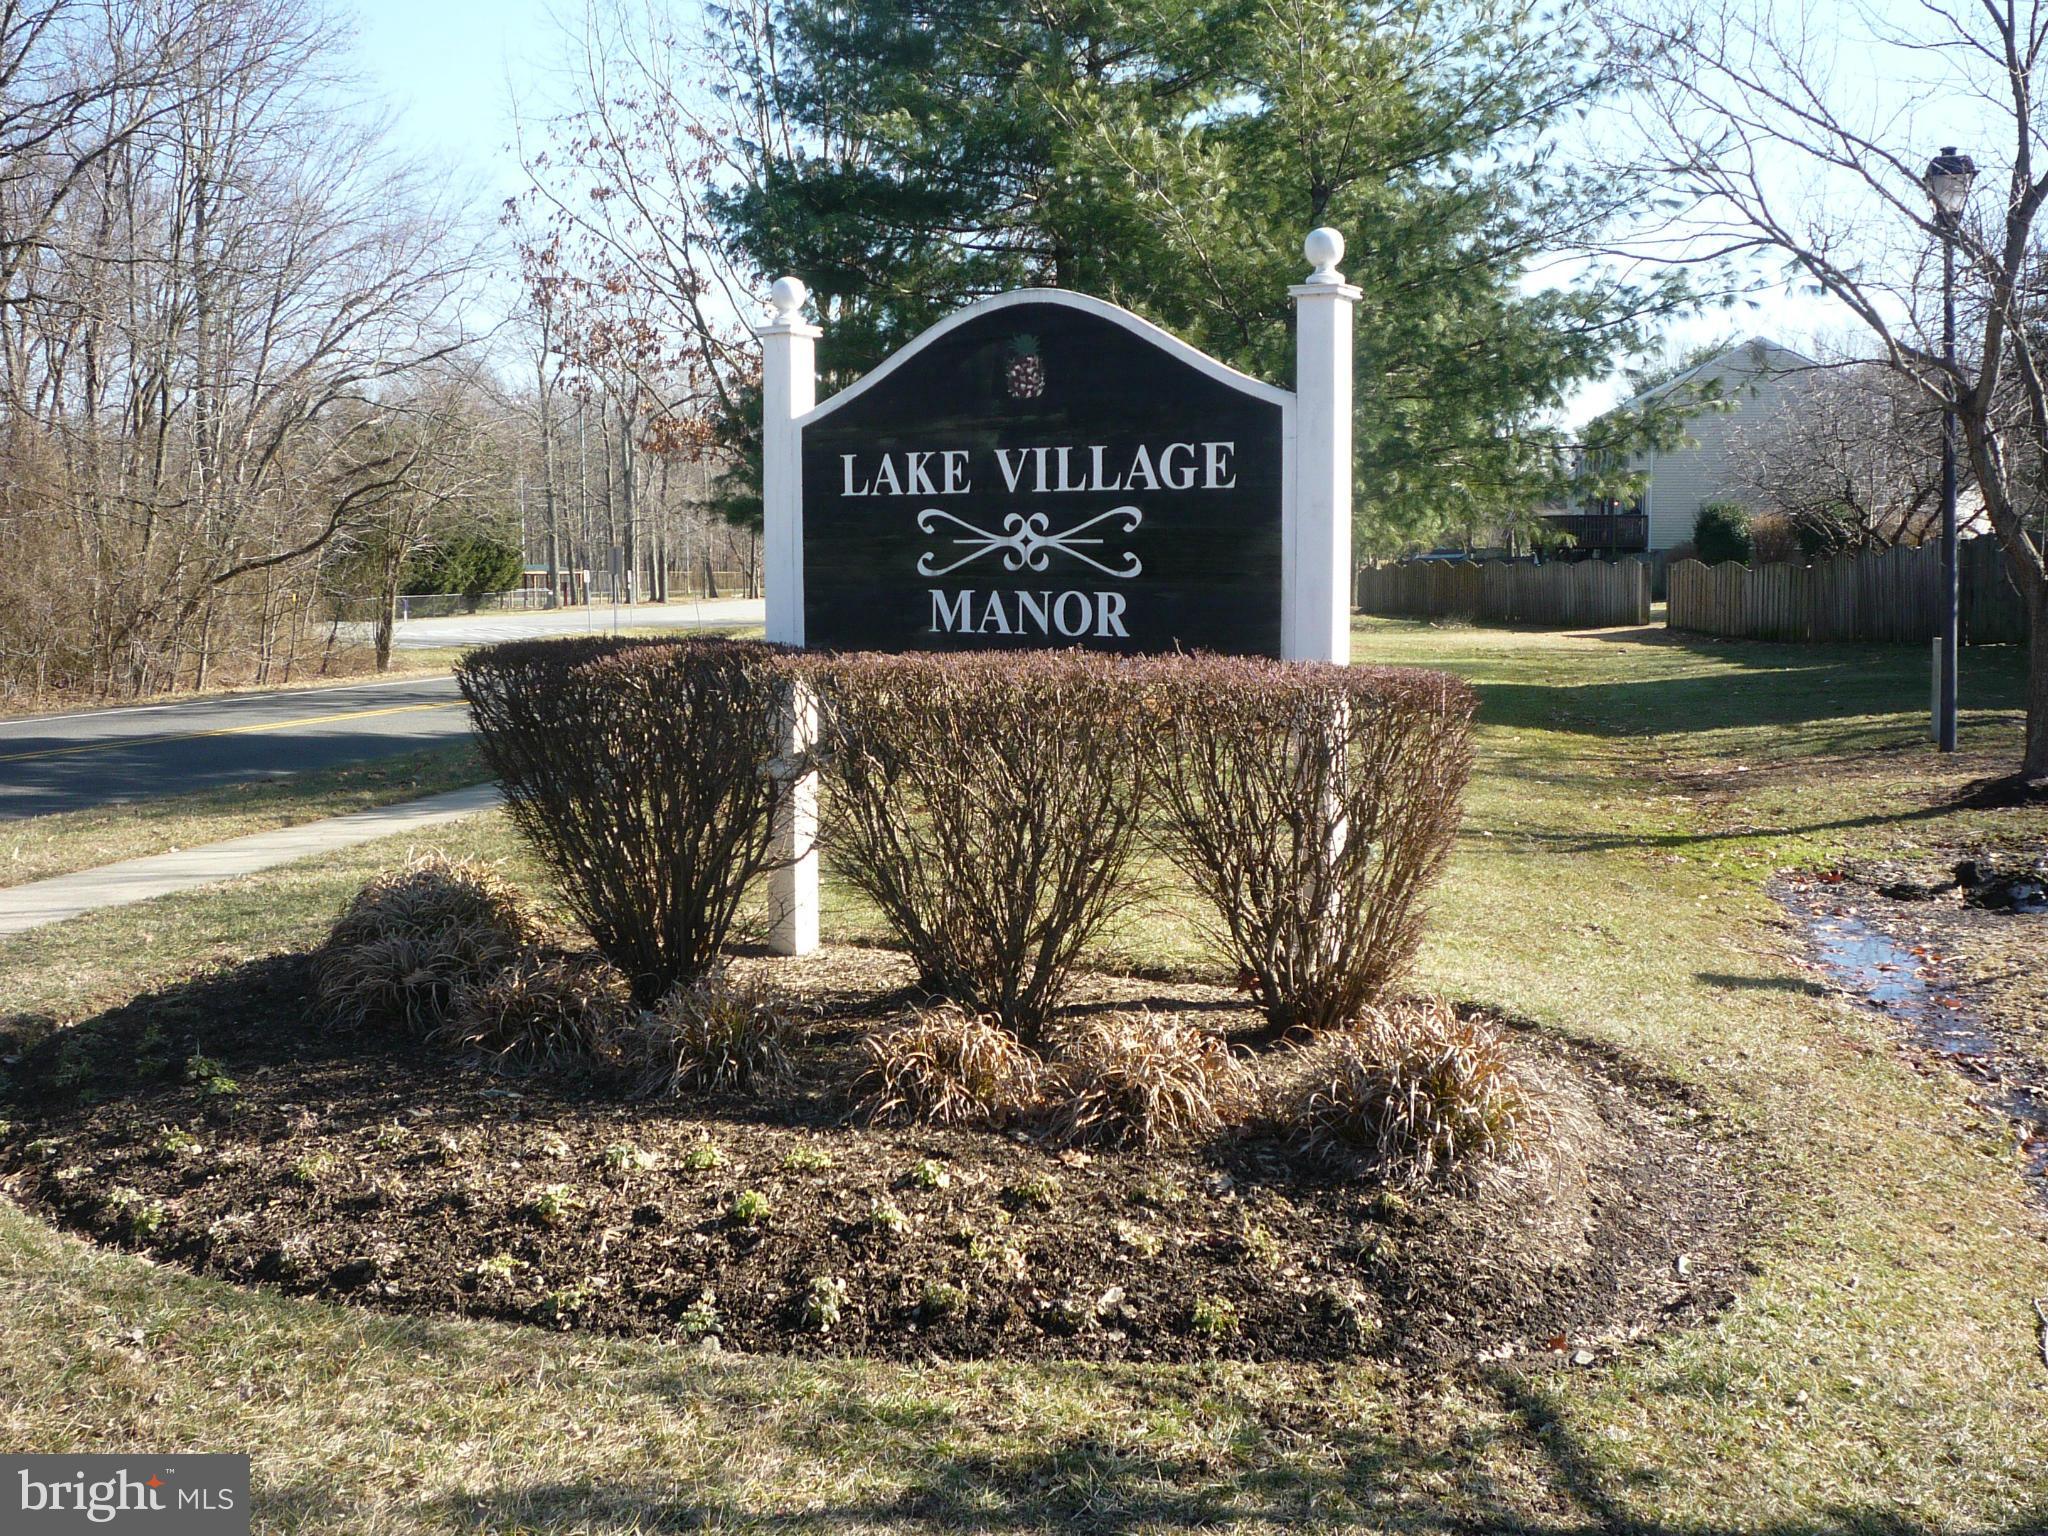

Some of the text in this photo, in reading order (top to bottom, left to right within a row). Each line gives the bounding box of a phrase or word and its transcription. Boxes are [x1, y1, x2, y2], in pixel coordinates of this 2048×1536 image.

[840, 441, 1237, 497] LAKE VILLAGE
[928, 589, 1131, 638] MANOR
